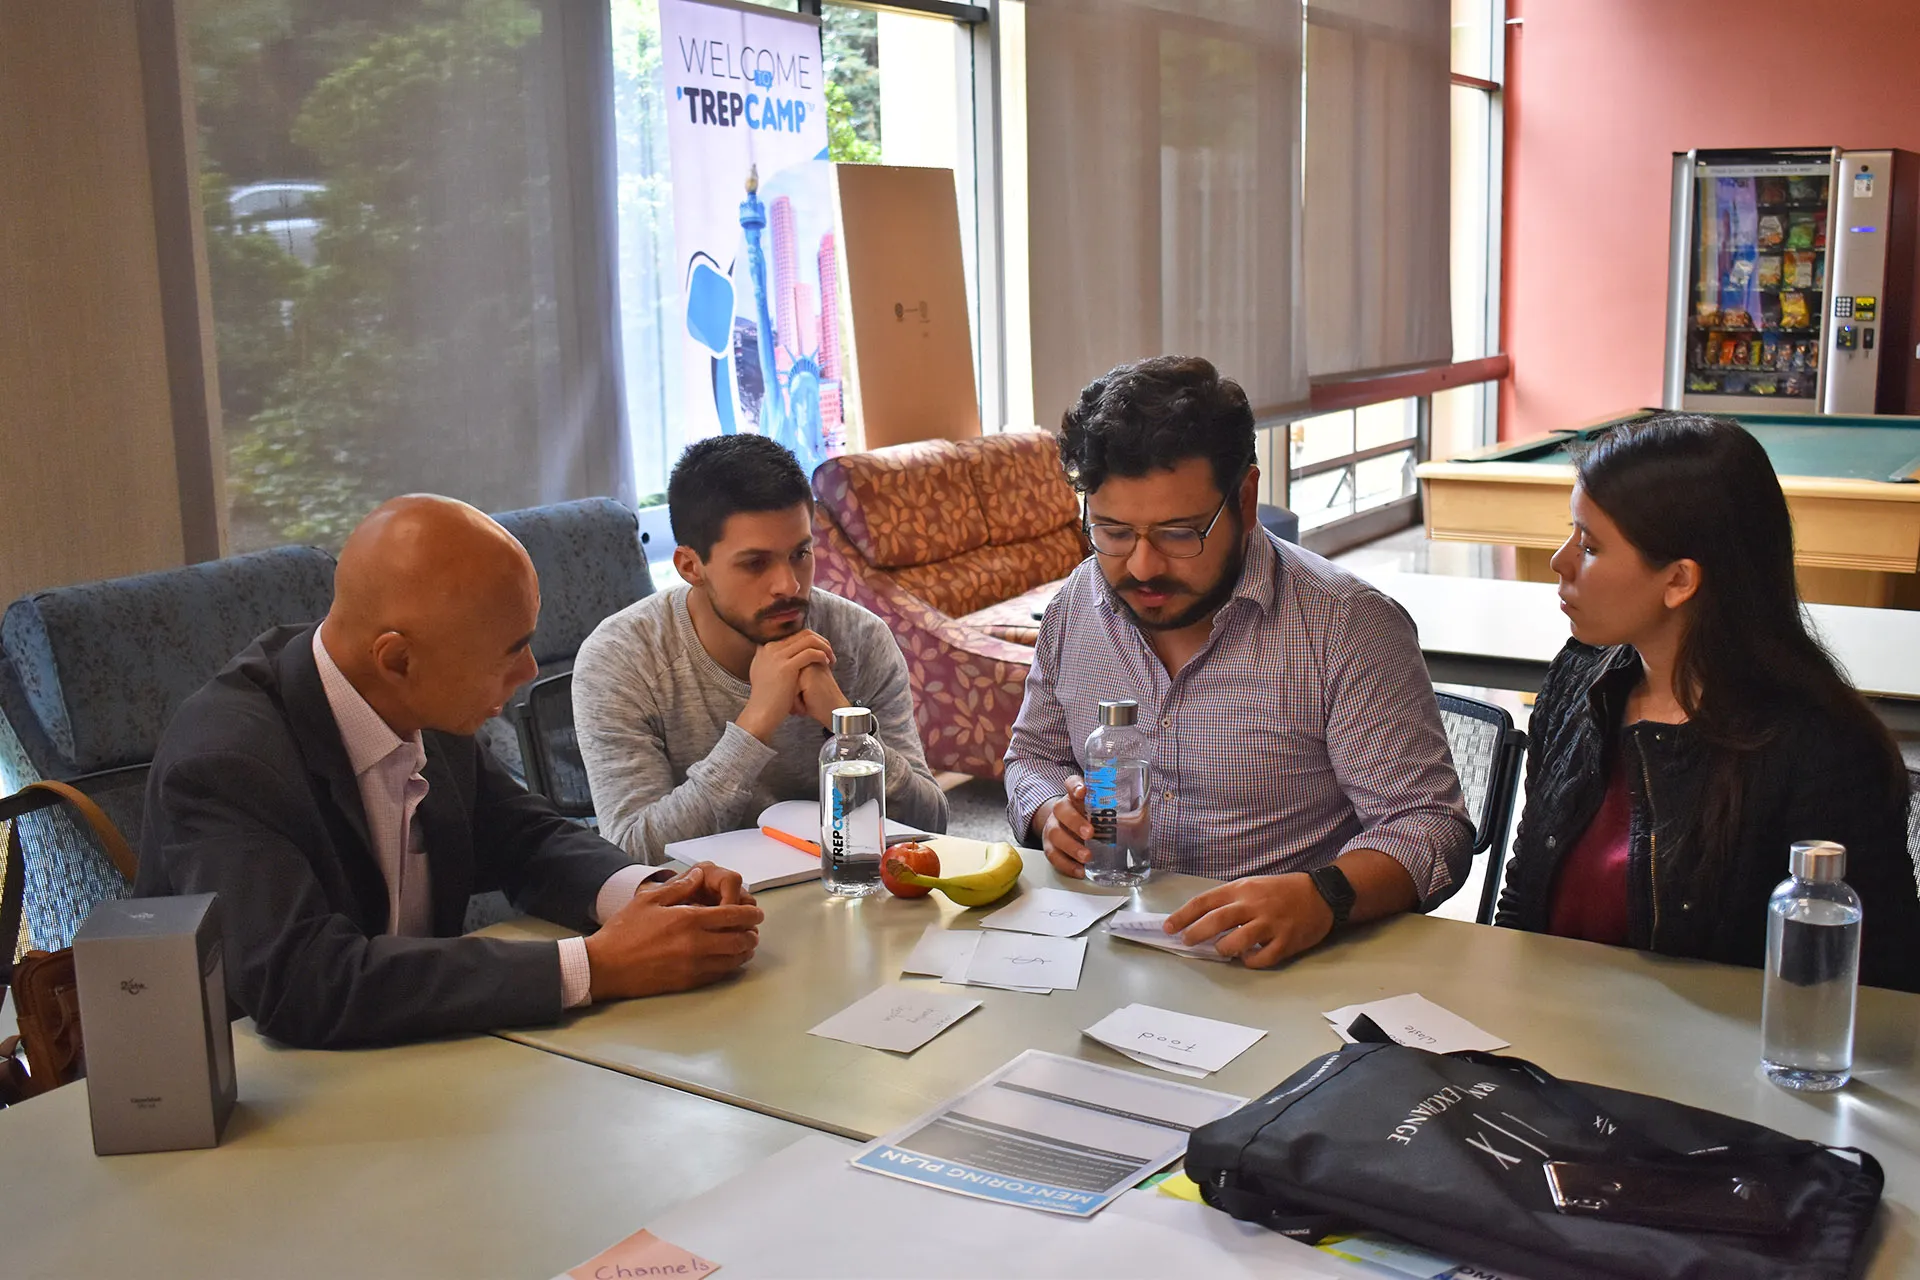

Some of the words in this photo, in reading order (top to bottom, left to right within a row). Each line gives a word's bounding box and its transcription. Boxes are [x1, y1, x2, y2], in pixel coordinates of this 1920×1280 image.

[678, 35, 812, 90] WELCOME
[1404, 1025, 1437, 1045] Waste
[1386, 1086, 1462, 1146] EXCHANGE
[880, 1150, 946, 1172] PLAN
[946, 1167, 1095, 1204] MENTORING
[595, 1257, 712, 1280] Channels
